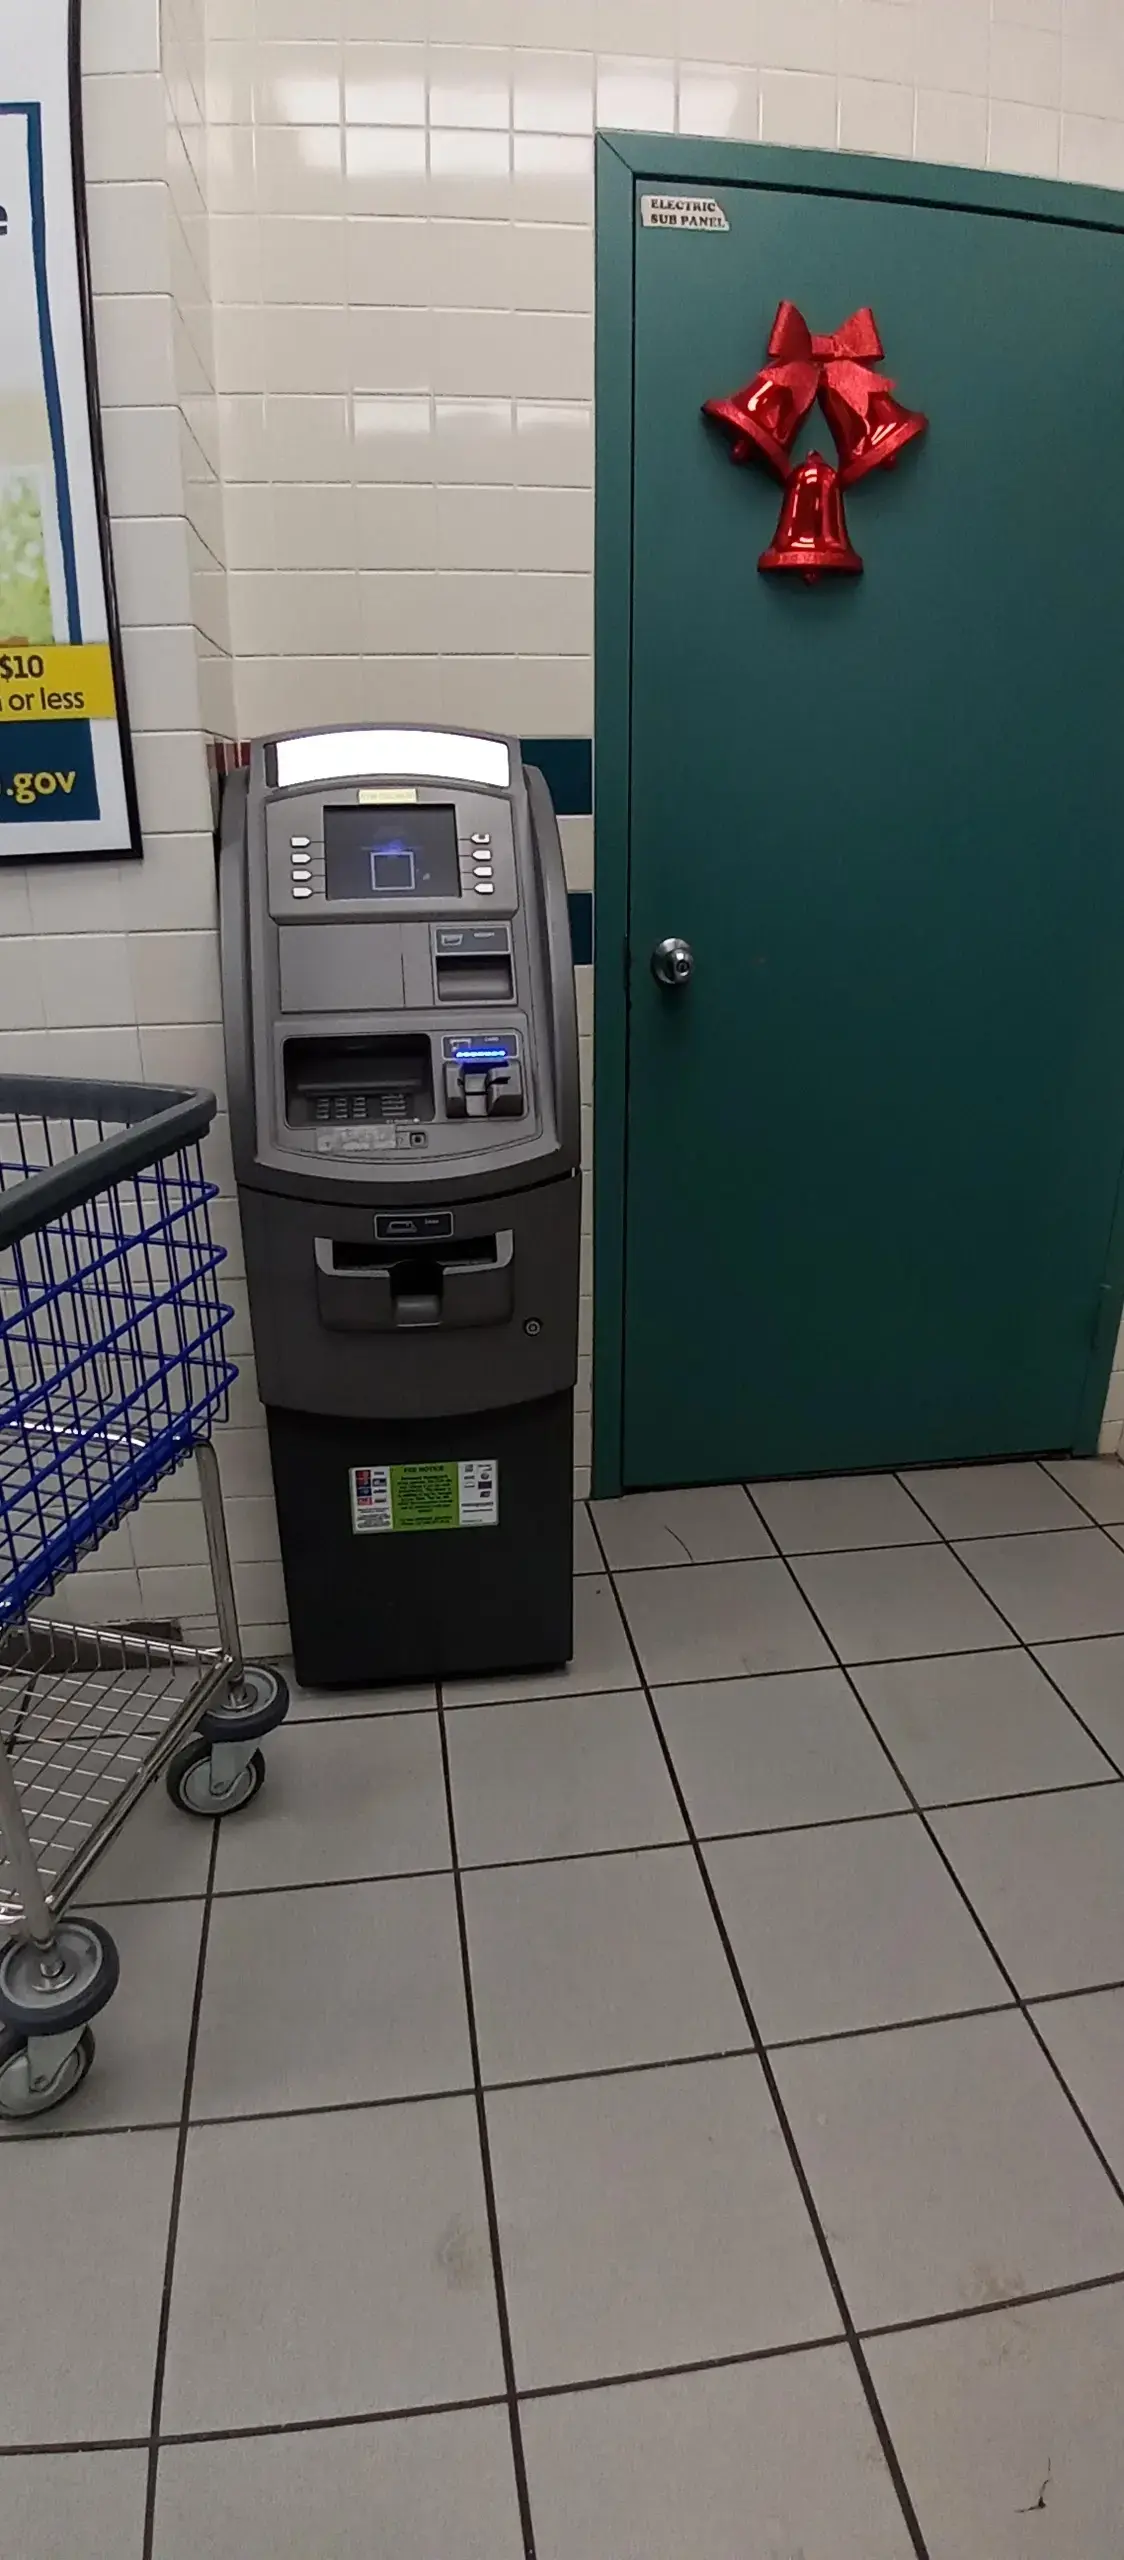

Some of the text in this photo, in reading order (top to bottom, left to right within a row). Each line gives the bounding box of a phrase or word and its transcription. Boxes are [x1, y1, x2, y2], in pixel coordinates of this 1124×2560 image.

[651, 199, 715, 212] ELECTRIC
[651, 214, 726, 229] SUB PANEL
[0, 655, 44, 683] $10
[8, 692, 35, 711] or
[40, 687, 85, 710] less
